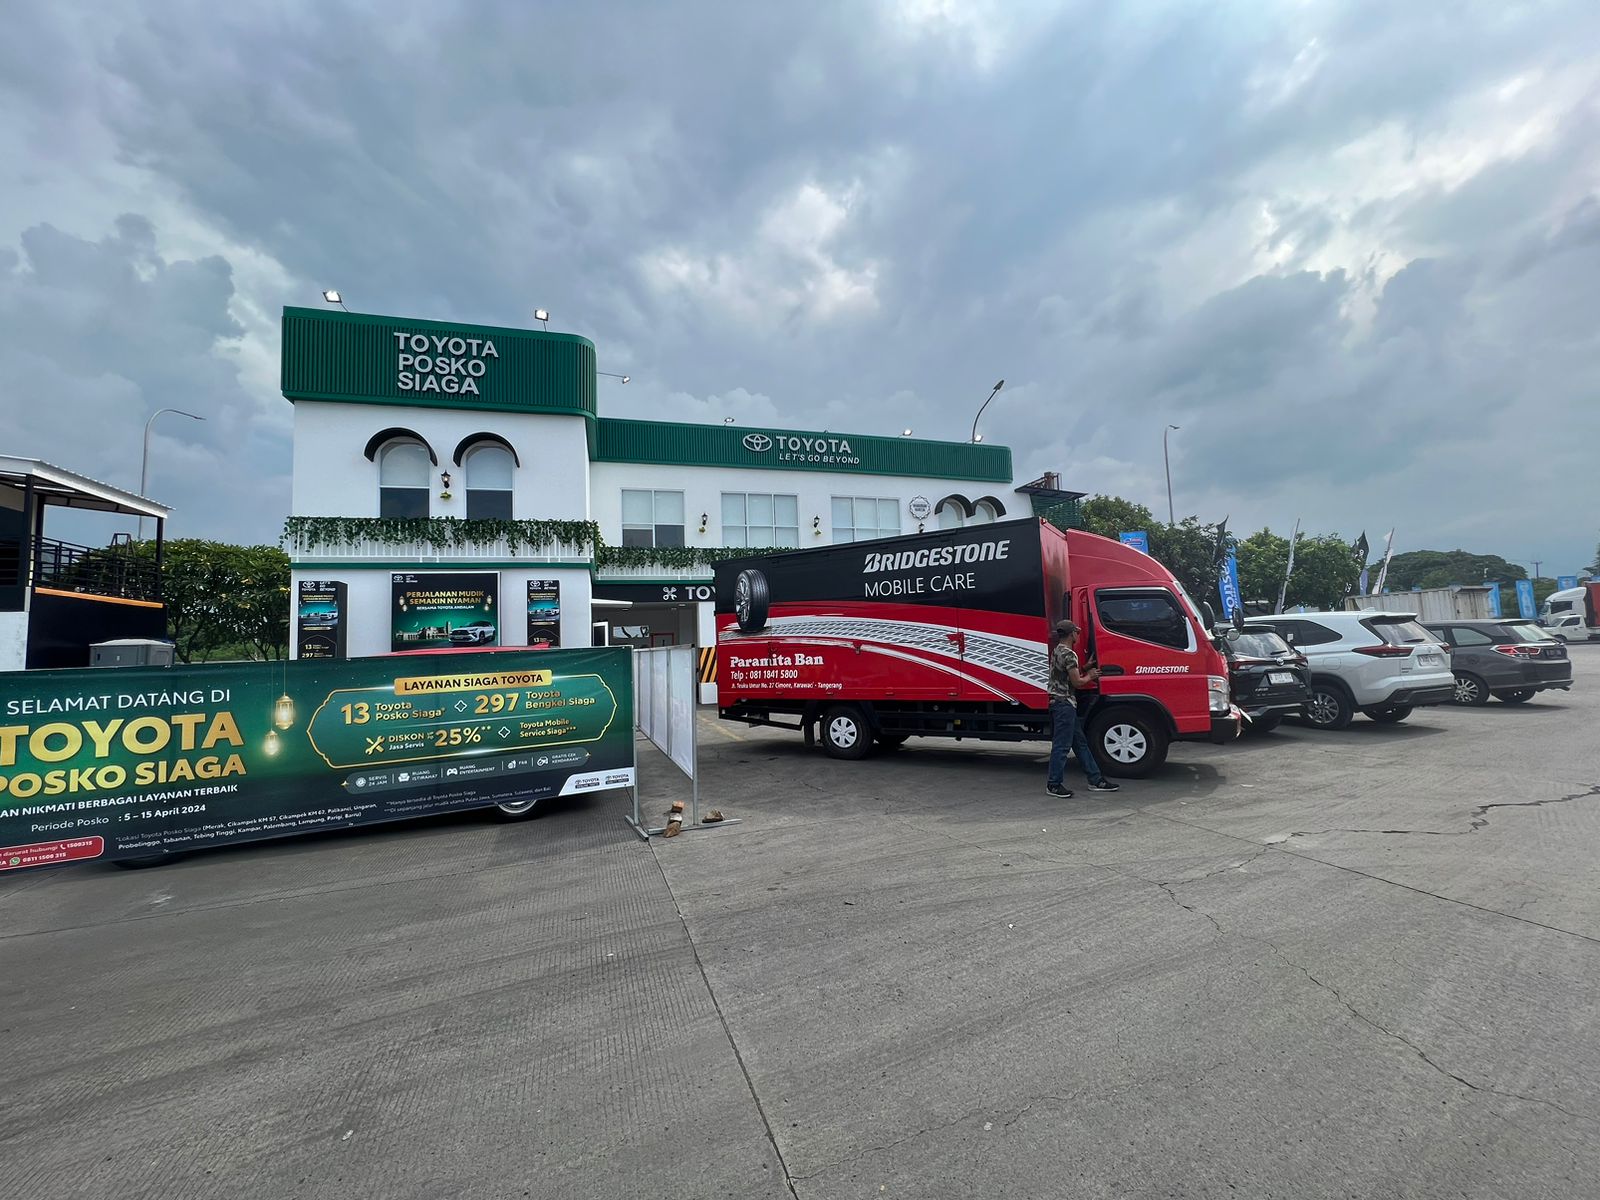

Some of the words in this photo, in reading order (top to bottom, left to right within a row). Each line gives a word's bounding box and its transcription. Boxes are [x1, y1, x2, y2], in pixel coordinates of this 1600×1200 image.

[393, 332, 499, 358] TOYOTA
[398, 353, 486, 377] POSKO
[397, 372, 480, 395] SIAGA
[776, 435, 852, 454] TOYOTA
[779, 452, 806, 462] LET'S
[808, 454, 820, 463] GO
[822, 455, 860, 465] BEYOND
[863, 540, 1010, 574] BRIDGESTONE
[864, 575, 926, 598] MOBILE
[930, 572, 975, 592] CARE
[794, 653, 824, 666] Ban
[731, 671, 744, 681] Telp
[749, 670, 761, 679] 081
[763, 670, 778, 679] 1841
[780, 669, 798, 678] 5800
[1135, 666, 1189, 674] BRIDGESTONE
[404, 678, 461, 692] LAYANAN
[464, 676, 498, 688] SIAGA
[500, 674, 543, 686] TOYOTA
[818, 682, 842, 690] Tangerang
[7, 695, 111, 715] SELAMAT
[118, 690, 203, 708] DATANG
[211, 689, 230, 702] DI
[525, 691, 560, 699] Toyota
[525, 700, 565, 709] Bengkel
[568, 697, 595, 706] Siaga
[341, 702, 371, 725] 13
[474, 693, 519, 714] 297
[375, 702, 412, 711] Toyota
[375, 711, 408, 721] Posko
[520, 721, 543, 729] Toyota
[0, 712, 244, 766] TOYOTA
[388, 732, 424, 743] DISKON
[135, 754, 247, 786] SIAGA
[23, 802, 75, 815] NIKMATI
[78, 795, 136, 809] BERBAGAI
[139, 789, 192, 802] LAYANAN
[194, 784, 238, 796] TERBAIK
[32, 820, 74, 832] Periode
[77, 816, 109, 826] Posko
[141, 810, 152, 819] 15
[154, 808, 179, 818] April
[181, 804, 206, 814] 2024
[228, 817, 256, 827] Cikampek
[279, 812, 307, 820] Cikampek
